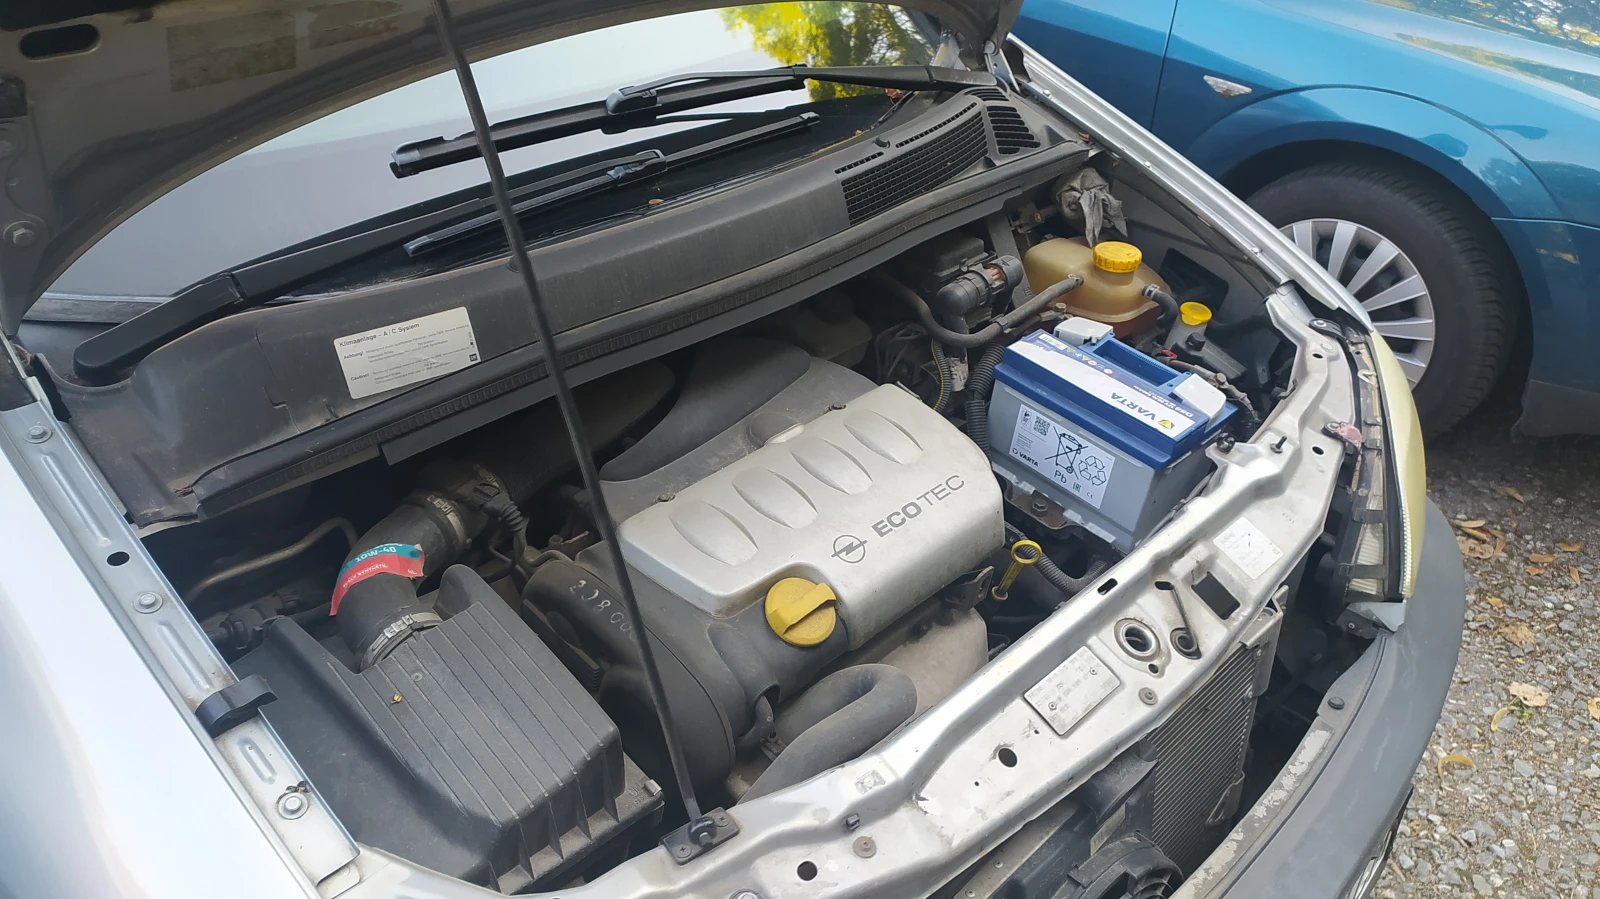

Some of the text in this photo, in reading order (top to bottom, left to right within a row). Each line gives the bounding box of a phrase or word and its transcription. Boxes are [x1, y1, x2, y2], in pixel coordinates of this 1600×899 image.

[339, 334, 377, 348] Klimaanlage
[398, 323, 420, 333] System
[1110, 392, 1157, 420] VARTA
[1019, 452, 1039, 467] VARTA
[1054, 470, 1067, 484] Pb
[871, 475, 965, 538] ECOTEC
[355, 546, 397, 563] 10W-40
